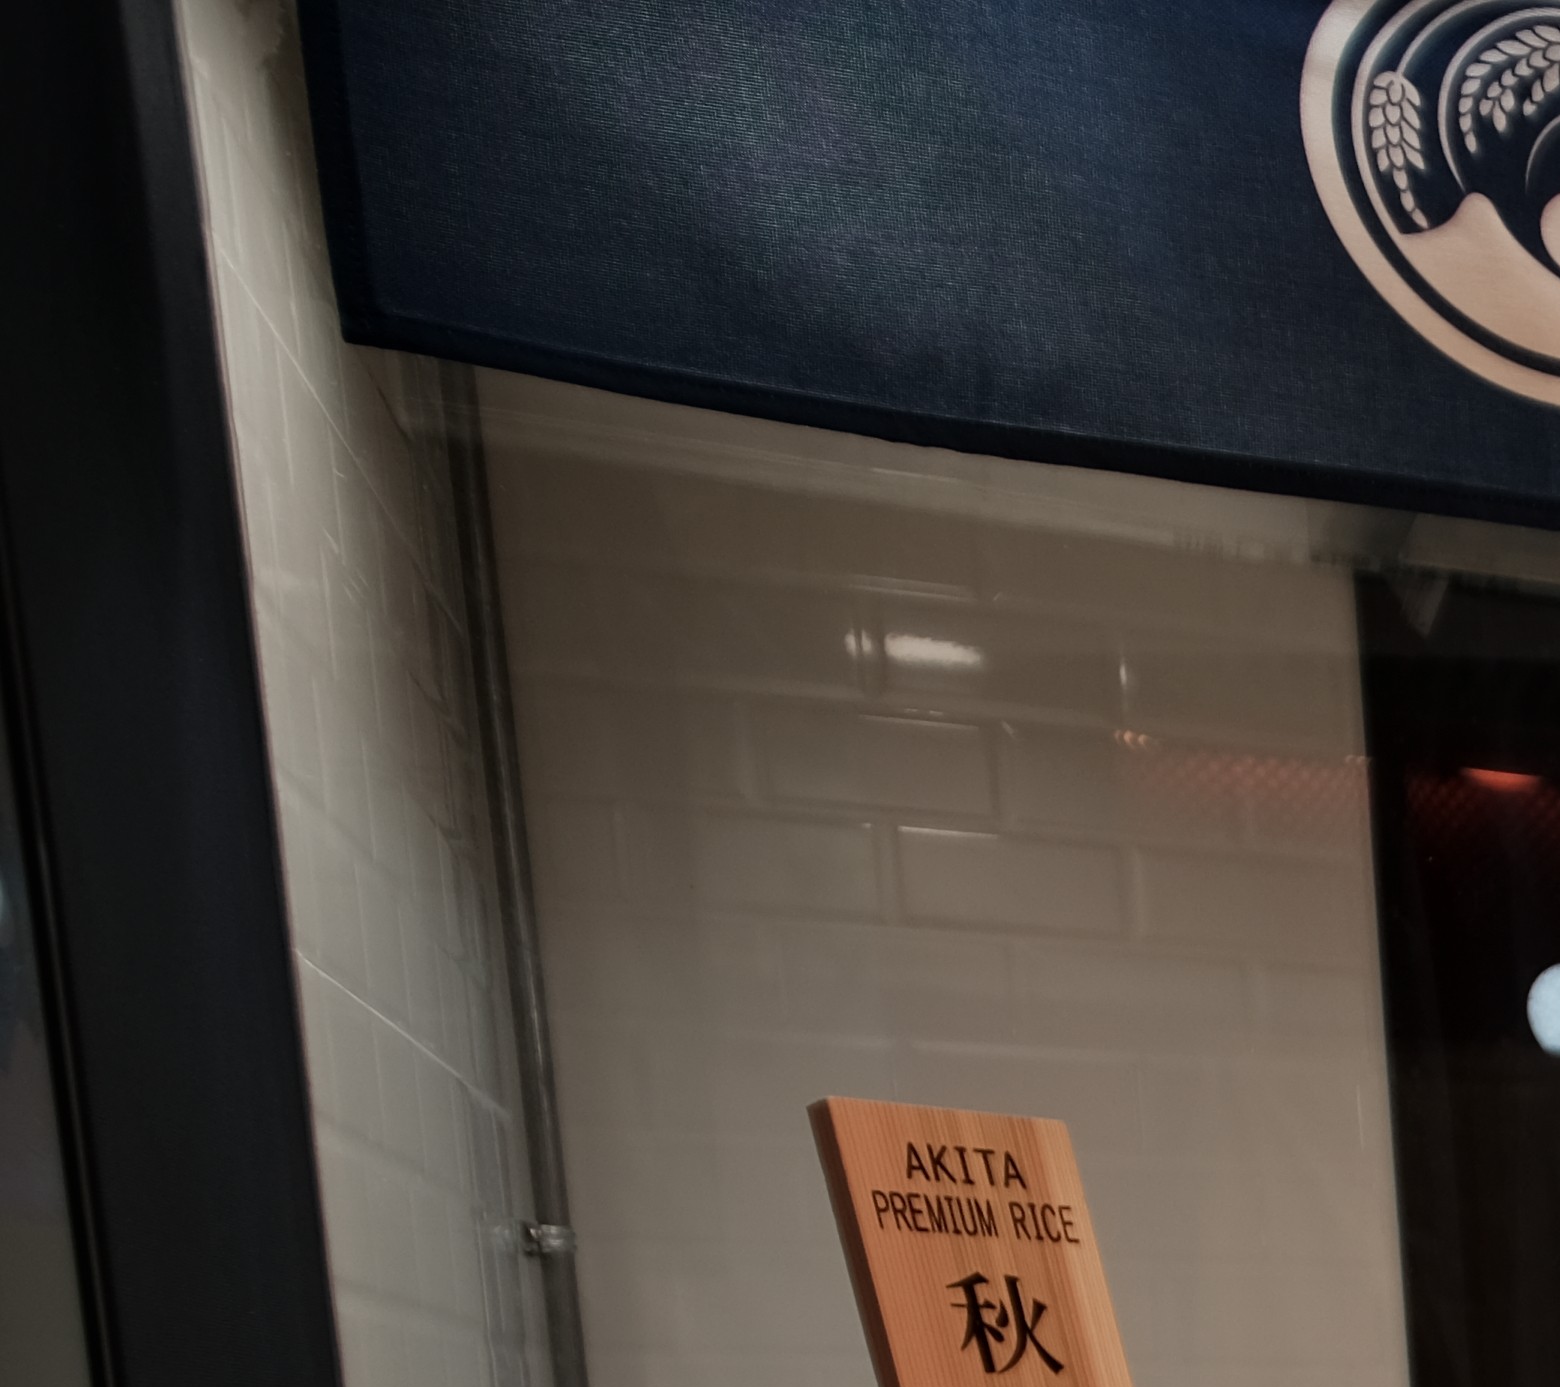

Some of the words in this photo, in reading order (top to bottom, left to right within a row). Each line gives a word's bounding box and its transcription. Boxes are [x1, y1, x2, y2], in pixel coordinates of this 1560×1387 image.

[905, 1143, 1028, 1190] AKITA
[872, 1190, 1000, 1238] PREMIUM
[999, 1201, 1081, 1247] RICE
